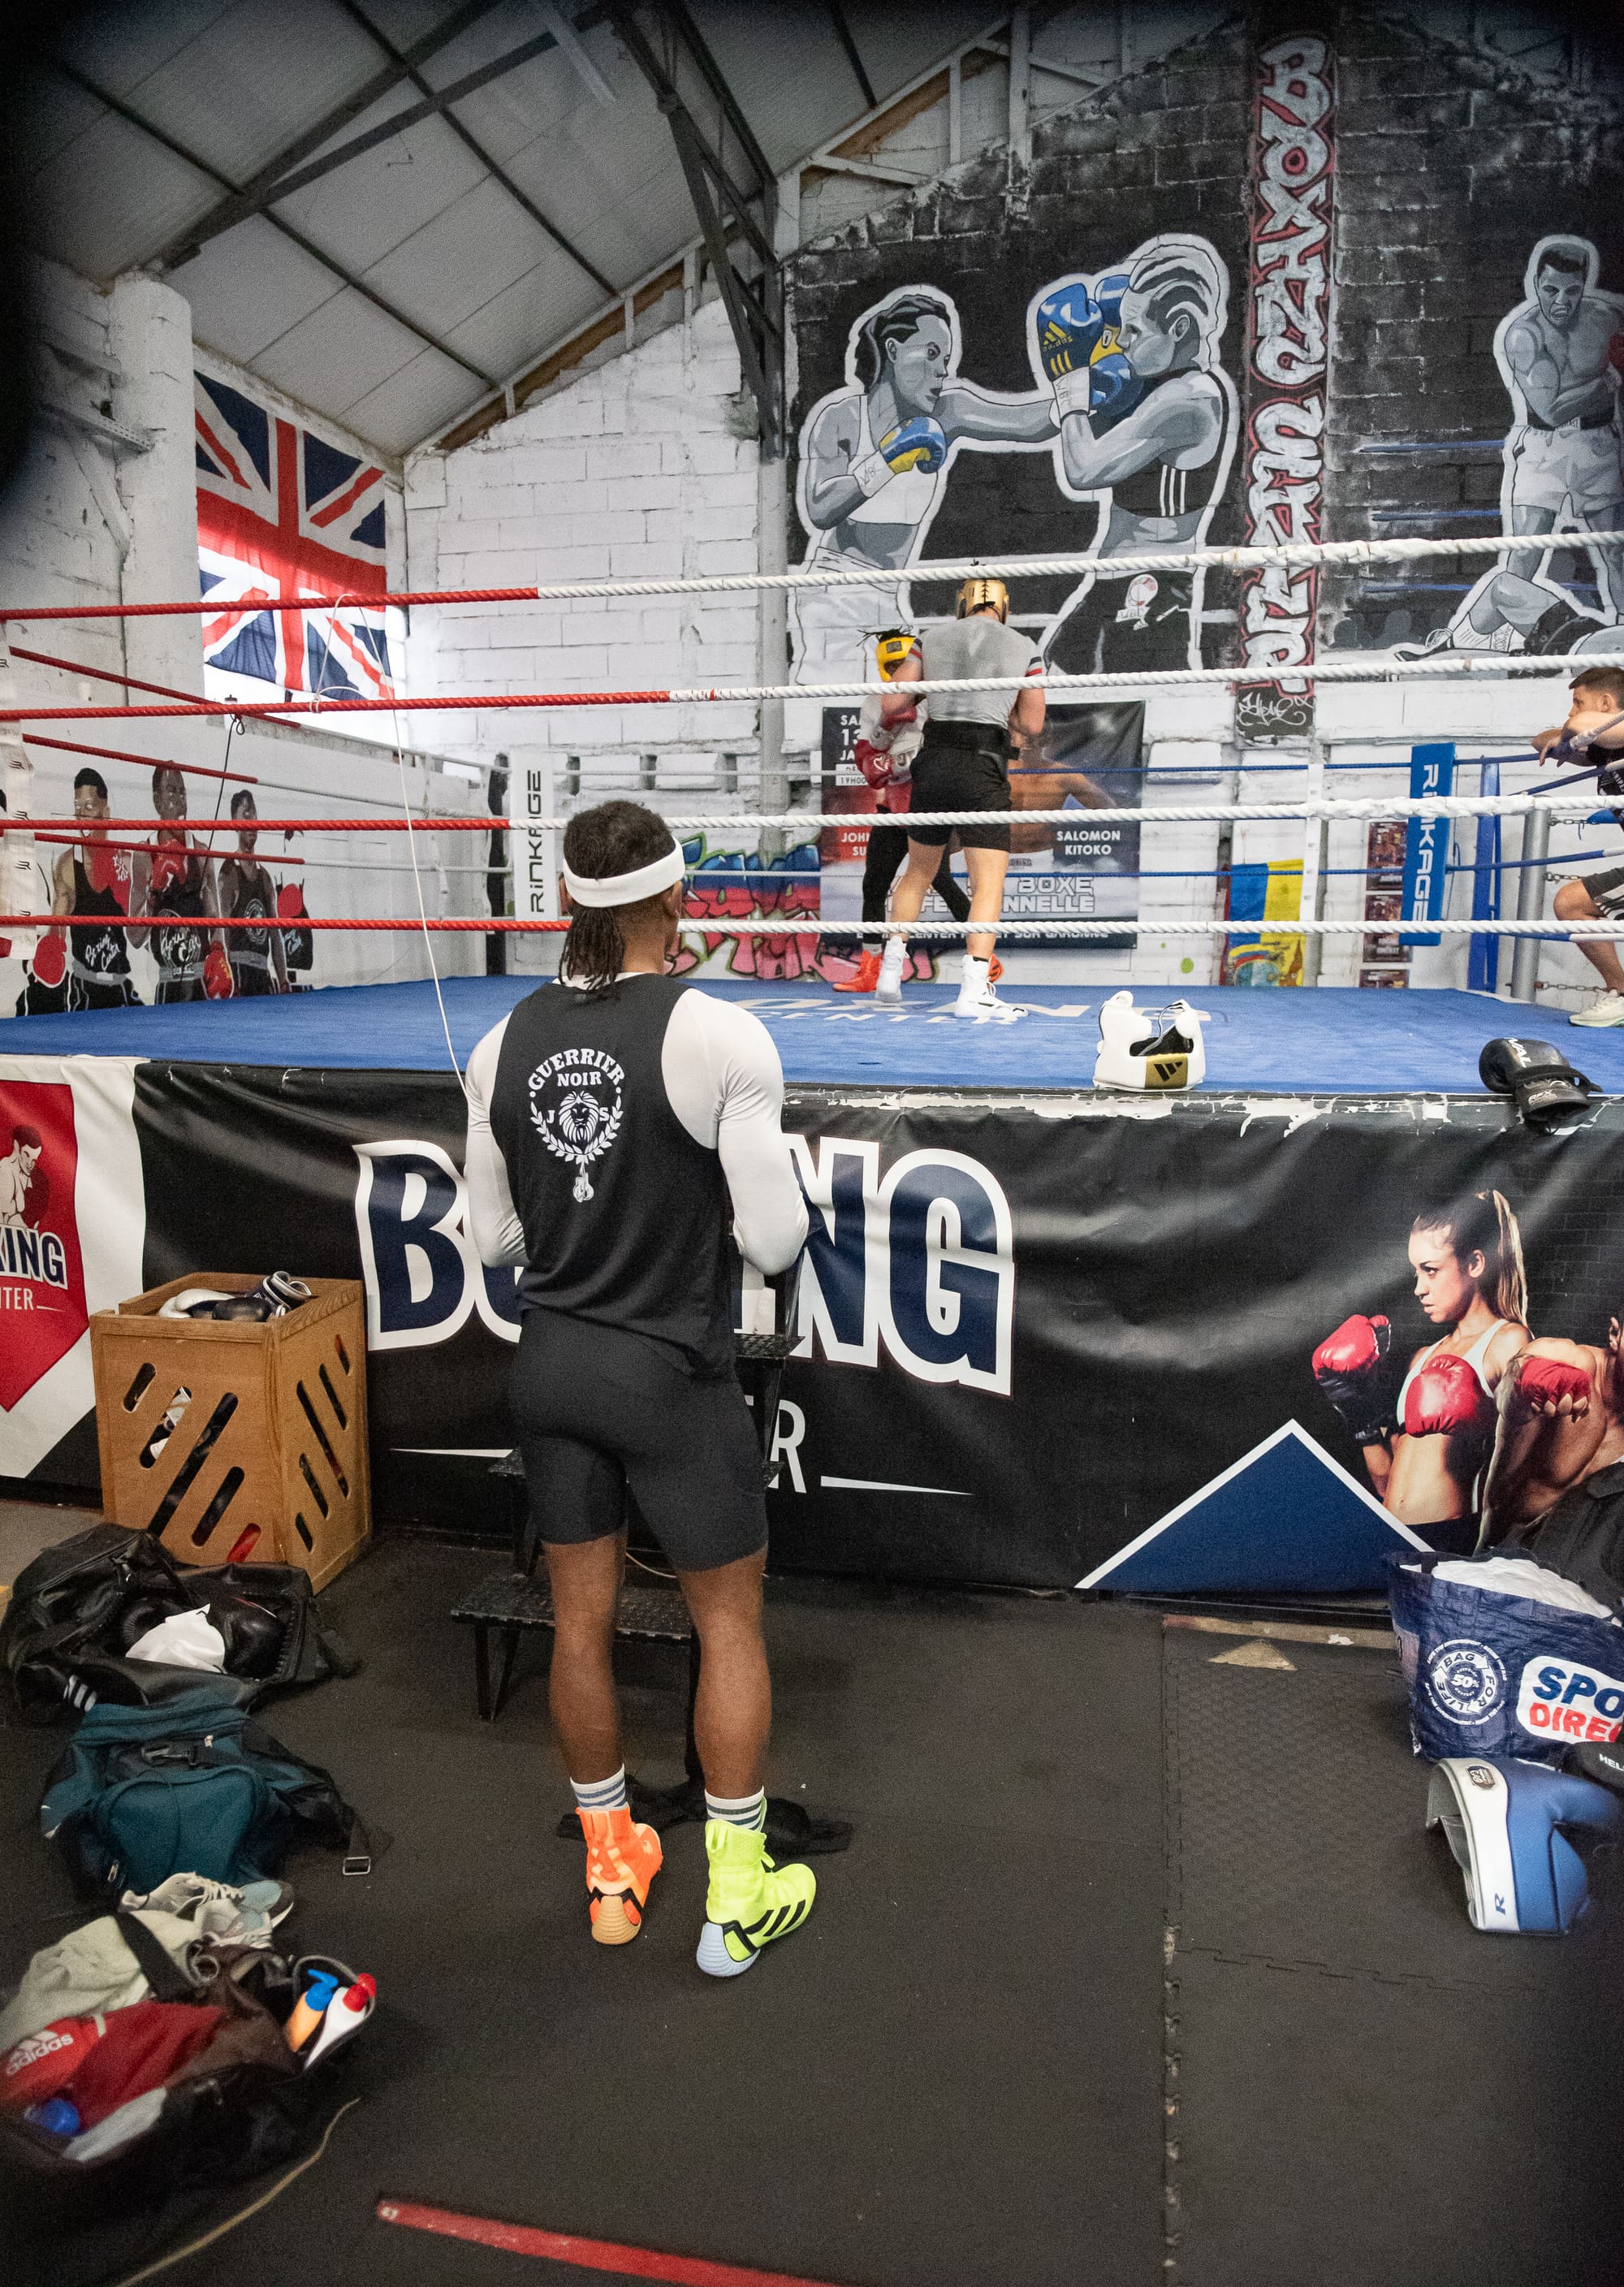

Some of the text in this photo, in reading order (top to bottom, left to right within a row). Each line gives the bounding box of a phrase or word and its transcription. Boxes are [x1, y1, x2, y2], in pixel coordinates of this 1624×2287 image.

[1255, 37, 1330, 385] BOXING
[840, 714, 862, 726] SA
[1056, 830, 1121, 841] SALOMON
[1412, 763, 1440, 922] RiKAGE
[1065, 845, 1112, 855] KITOKO
[1017, 876, 1095, 895] BOXE
[528, 1048, 625, 1090] GUERRIER
[557, 1071, 602, 1087] NOIR
[546, 1106, 610, 1124] J S
[353, 1134, 1014, 1396] BNG
[0, 1286, 34, 1310] TER
[1444, 1653, 1475, 1667] BAG
[1450, 1673, 1479, 1688] 50%
[1478, 1675, 1495, 1707] FOR
[1436, 1680, 1465, 1710] LIFE
[6, 2032, 74, 2076] adidas
